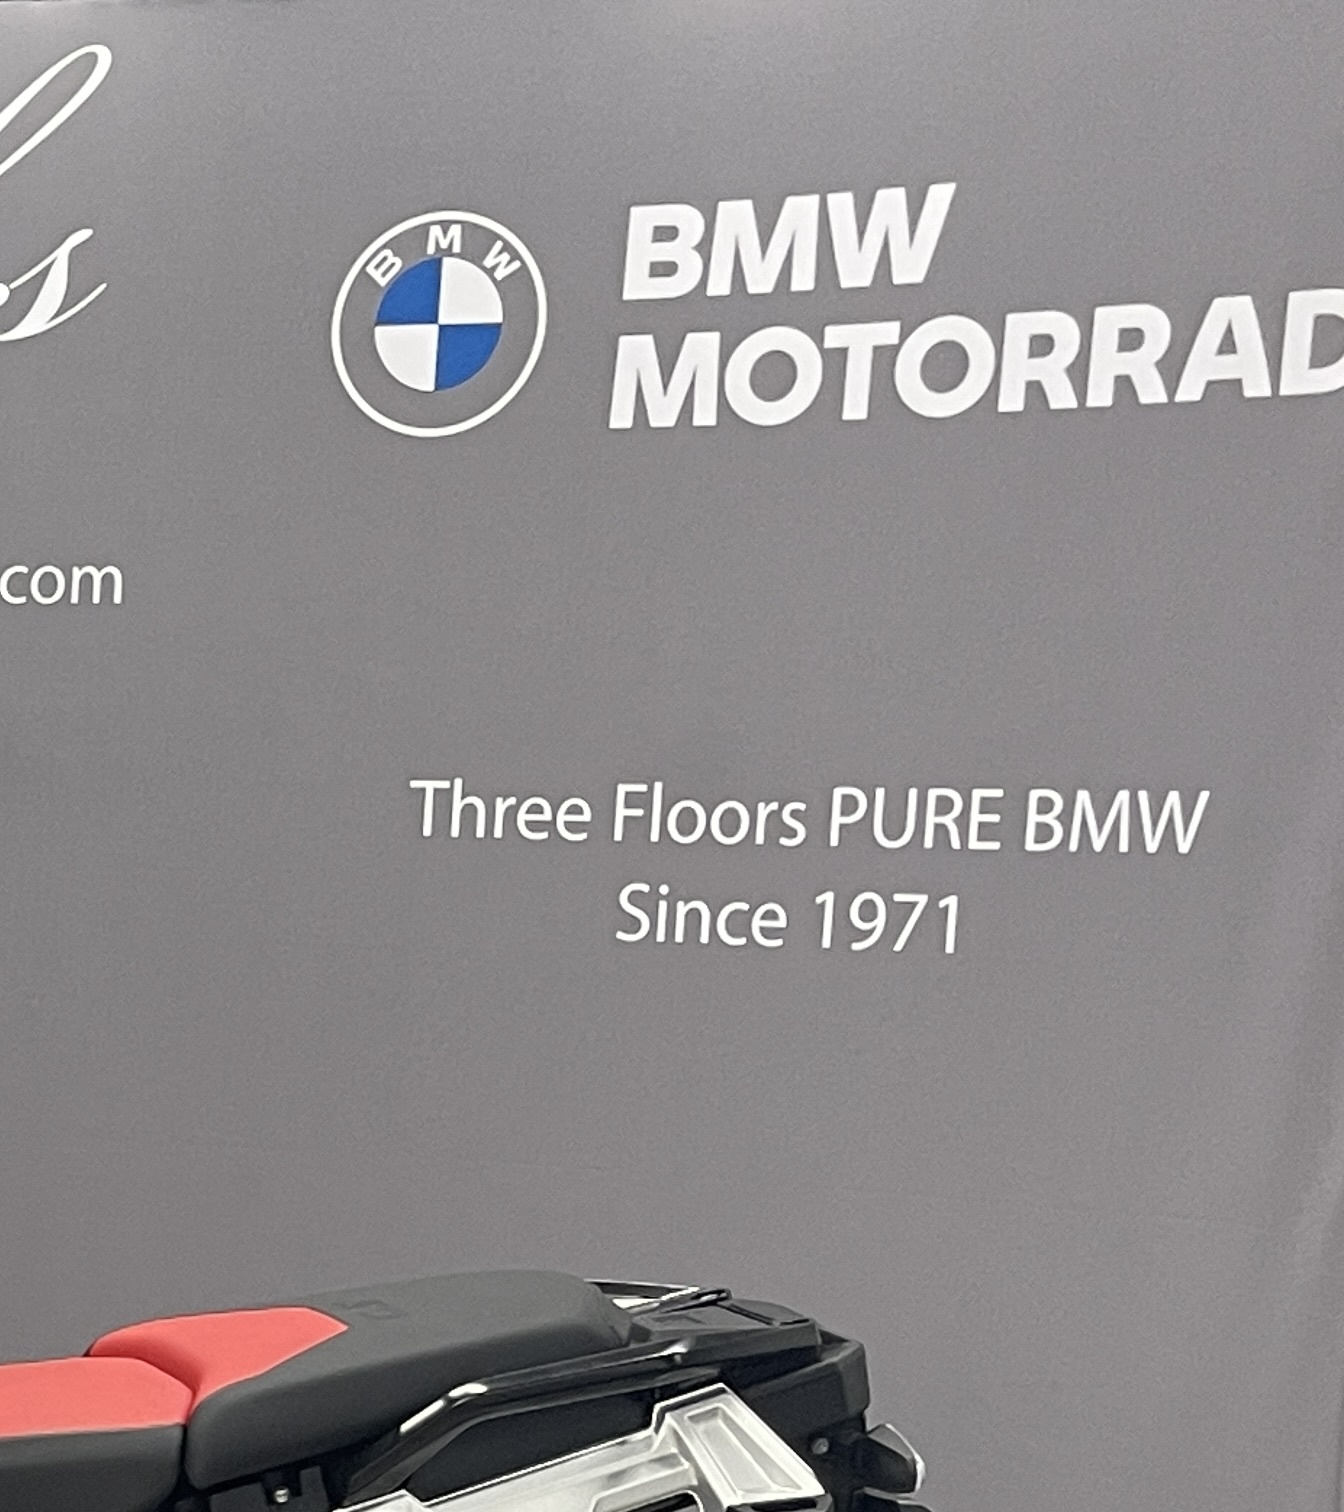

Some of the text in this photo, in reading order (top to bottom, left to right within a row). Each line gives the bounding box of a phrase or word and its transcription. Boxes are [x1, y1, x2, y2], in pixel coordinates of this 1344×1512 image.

[366, 223, 521, 287] BMW
[622, 183, 957, 300] BMW
[608, 288, 1344, 429] MOTORRAD
[409, 777, 1210, 854] Three Floors PURE BMW
[615, 882, 959, 954] Since 1971
